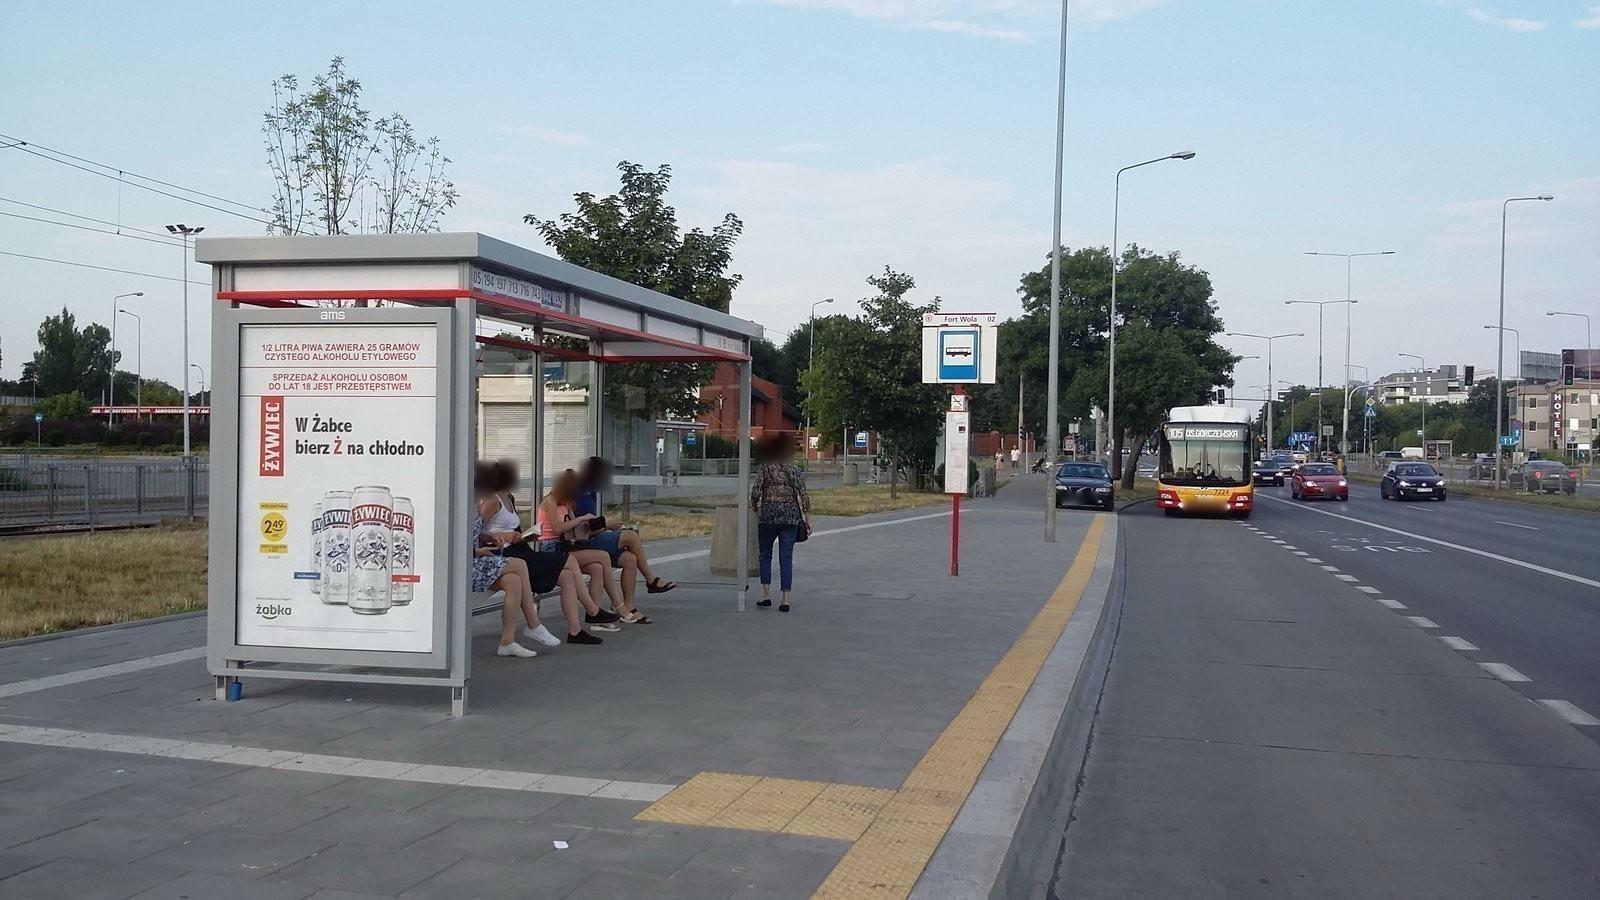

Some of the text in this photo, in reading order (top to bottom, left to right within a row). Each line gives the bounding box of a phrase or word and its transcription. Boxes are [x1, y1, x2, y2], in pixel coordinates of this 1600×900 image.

[320, 310, 345, 320] ams
[262, 341, 420, 352] 1/2 LITRA PIWA ZAWIERA 25 GRAMÓW
[264, 353, 416, 361] CZYSTEGO ALKOHOLU ETYLOWEGO
[272, 372, 408, 381] SPRZEDAŻ ALKOHOLU OSOBOM
[268, 382, 412, 392] DO LAT 18 JEST PRZESTĘPSTWEM
[295, 413, 353, 433] W Żabce
[261, 402, 281, 472] ŻYWIEC
[1169, 428, 1183, 438] 105
[295, 435, 425, 456] bierz Ż na chłodno
[324, 510, 350, 524] ŻYWI
[256, 603, 292, 616] żabka
